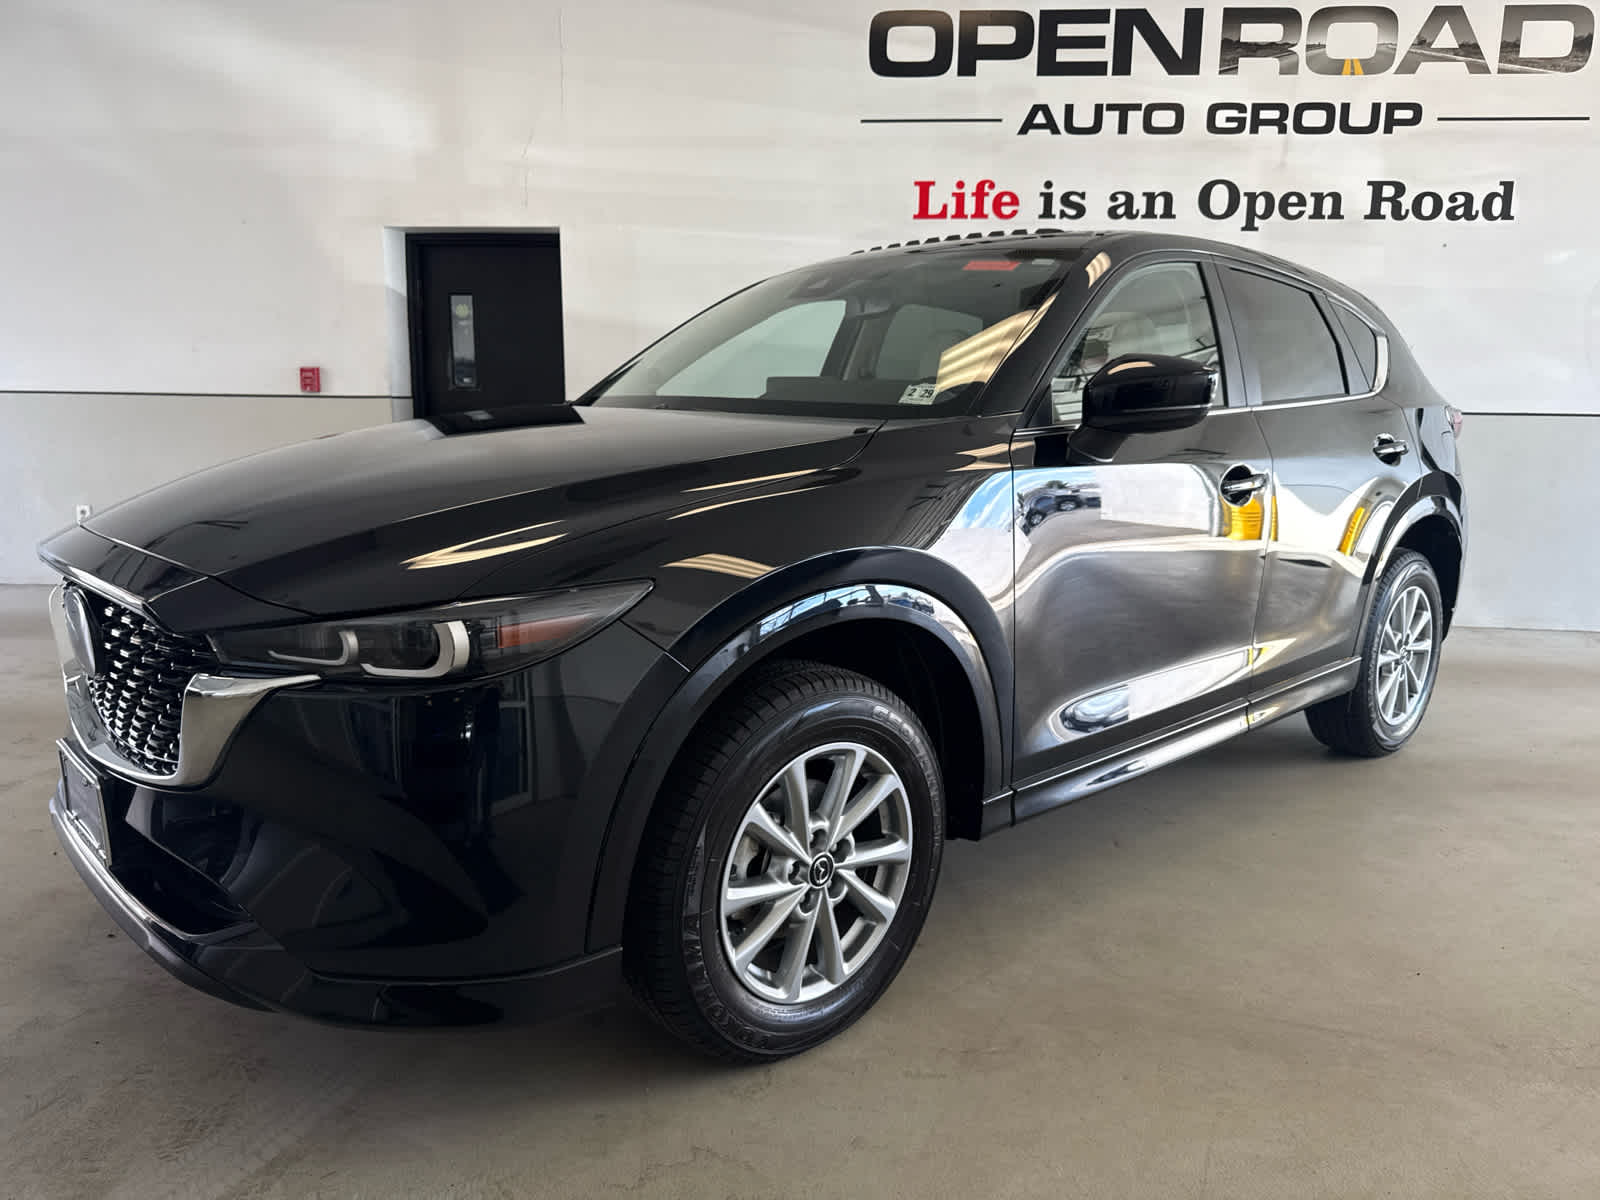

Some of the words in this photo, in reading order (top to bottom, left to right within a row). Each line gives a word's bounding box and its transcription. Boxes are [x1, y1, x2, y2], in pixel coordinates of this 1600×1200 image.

[868, 7, 1205, 78] OPEN
[1218, 4, 1595, 76] ROAD
[1016, 102, 1185, 136] AUTO
[1206, 101, 1423, 135] GROUP
[912, 179, 1020, 221] Life
[1037, 180, 1087, 221] is
[1107, 190, 1177, 221] an
[1197, 178, 1345, 232] Open
[1363, 180, 1515, 222] Road
